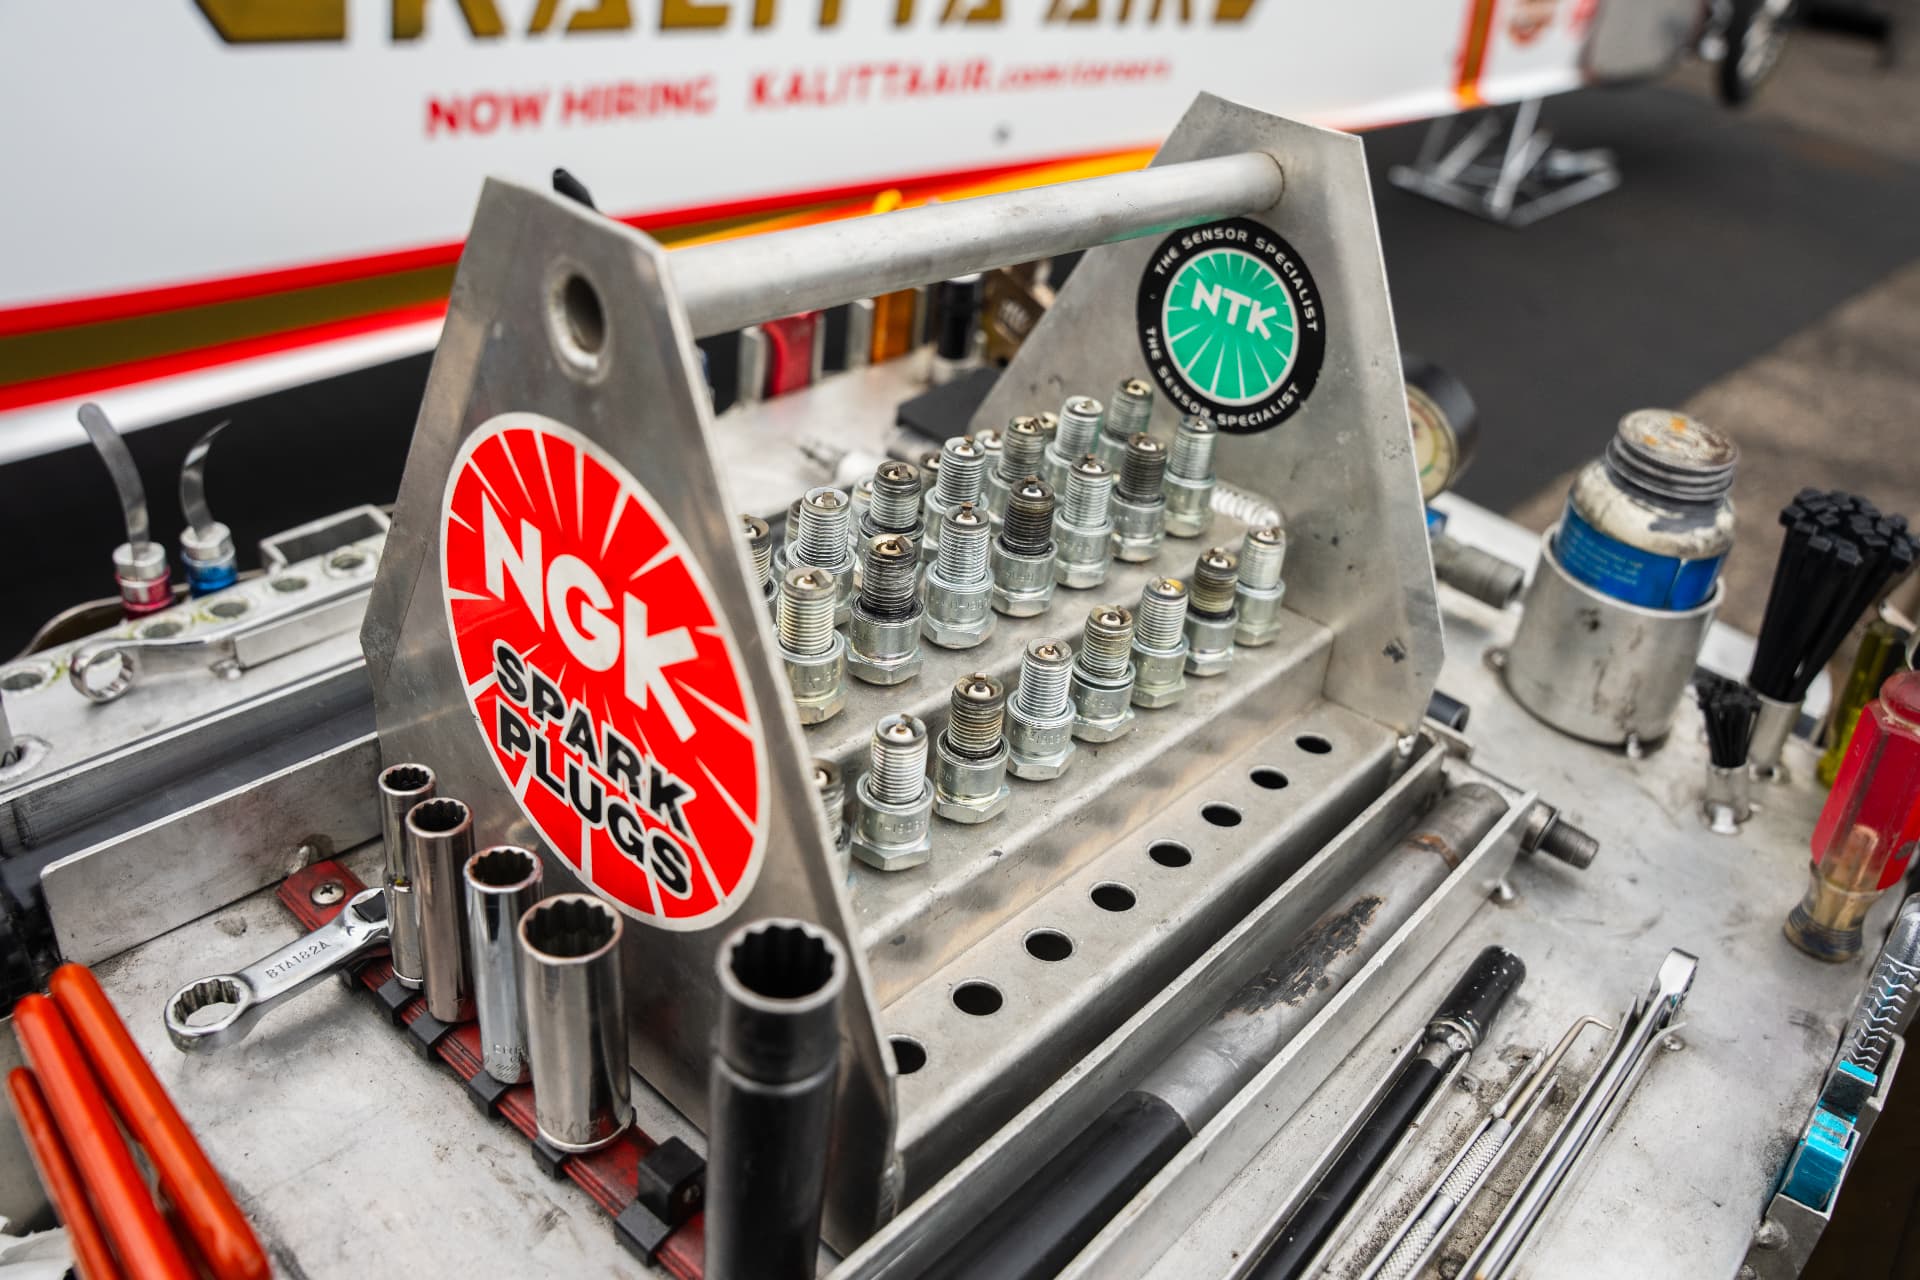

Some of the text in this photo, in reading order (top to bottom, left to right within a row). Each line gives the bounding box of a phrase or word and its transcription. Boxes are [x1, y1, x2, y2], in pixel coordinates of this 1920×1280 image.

[426, 91, 548, 137] NOW
[561, 76, 714, 124] HIRING
[1154, 227, 1319, 332] THE SENSOR SPECIALIST
[1191, 278, 1277, 340] NTK
[1146, 327, 1300, 427] THE SENSOR SPECIALIST
[481, 490, 699, 742] NGK
[493, 640, 696, 845] SPARK
[496, 696, 692, 898] PLUGS
